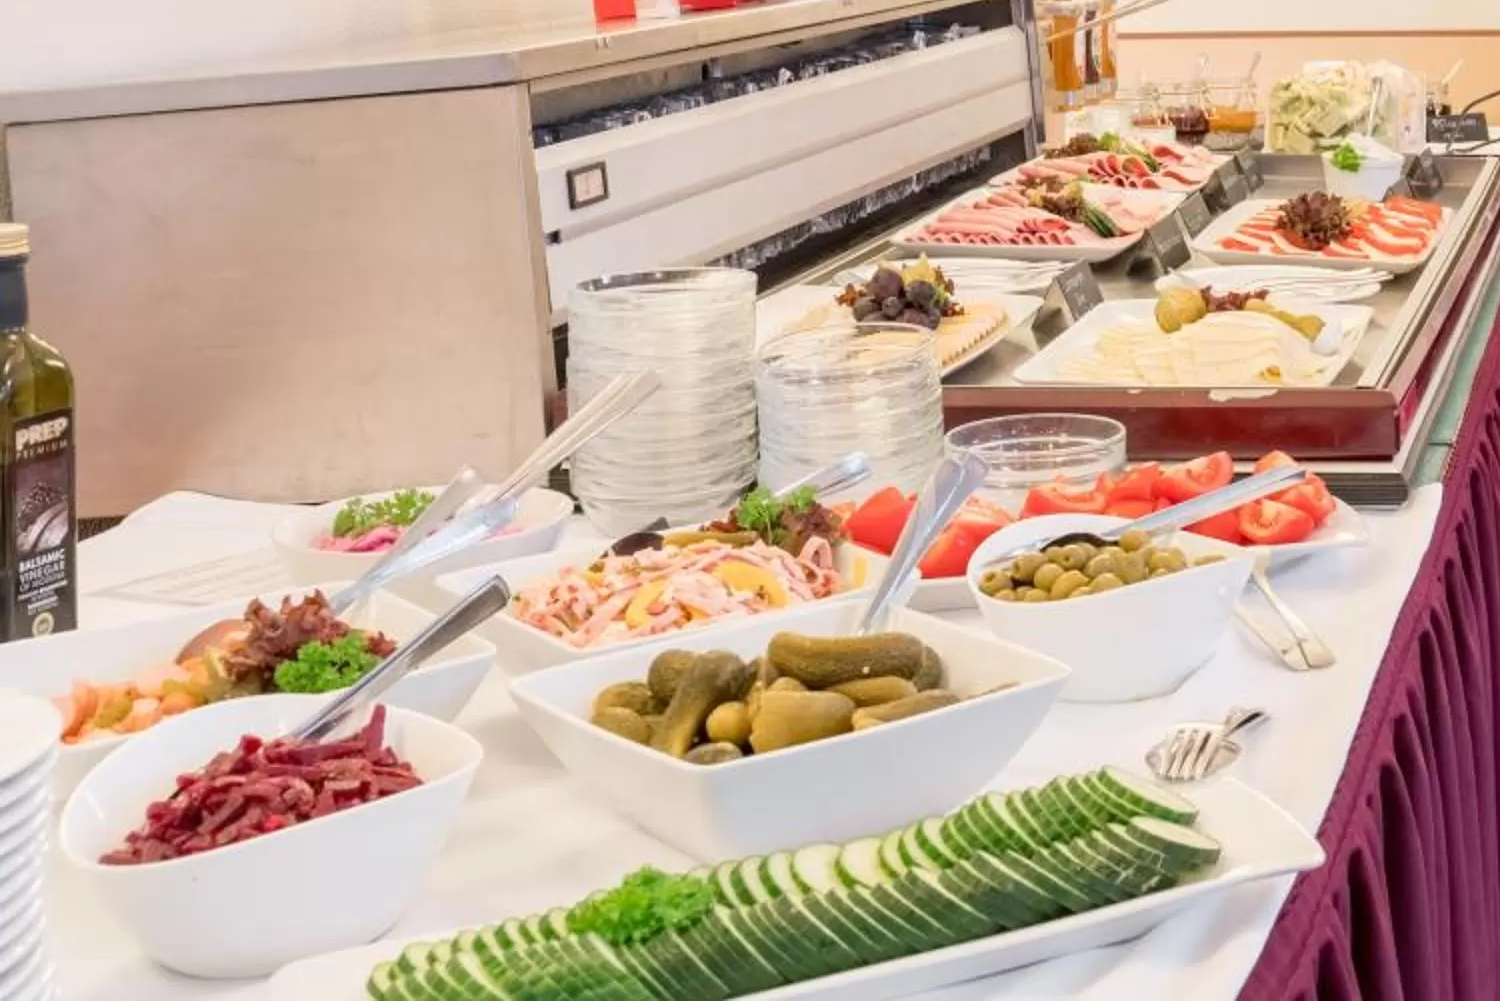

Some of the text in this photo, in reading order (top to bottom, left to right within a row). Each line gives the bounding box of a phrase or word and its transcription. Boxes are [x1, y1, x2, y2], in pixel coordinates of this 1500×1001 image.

[15, 416, 69, 451] PREP
[15, 439, 68, 464] PREMIUM
[19, 547, 65, 572] BALSAMIC
[19, 560, 65, 583] VINEGAR
